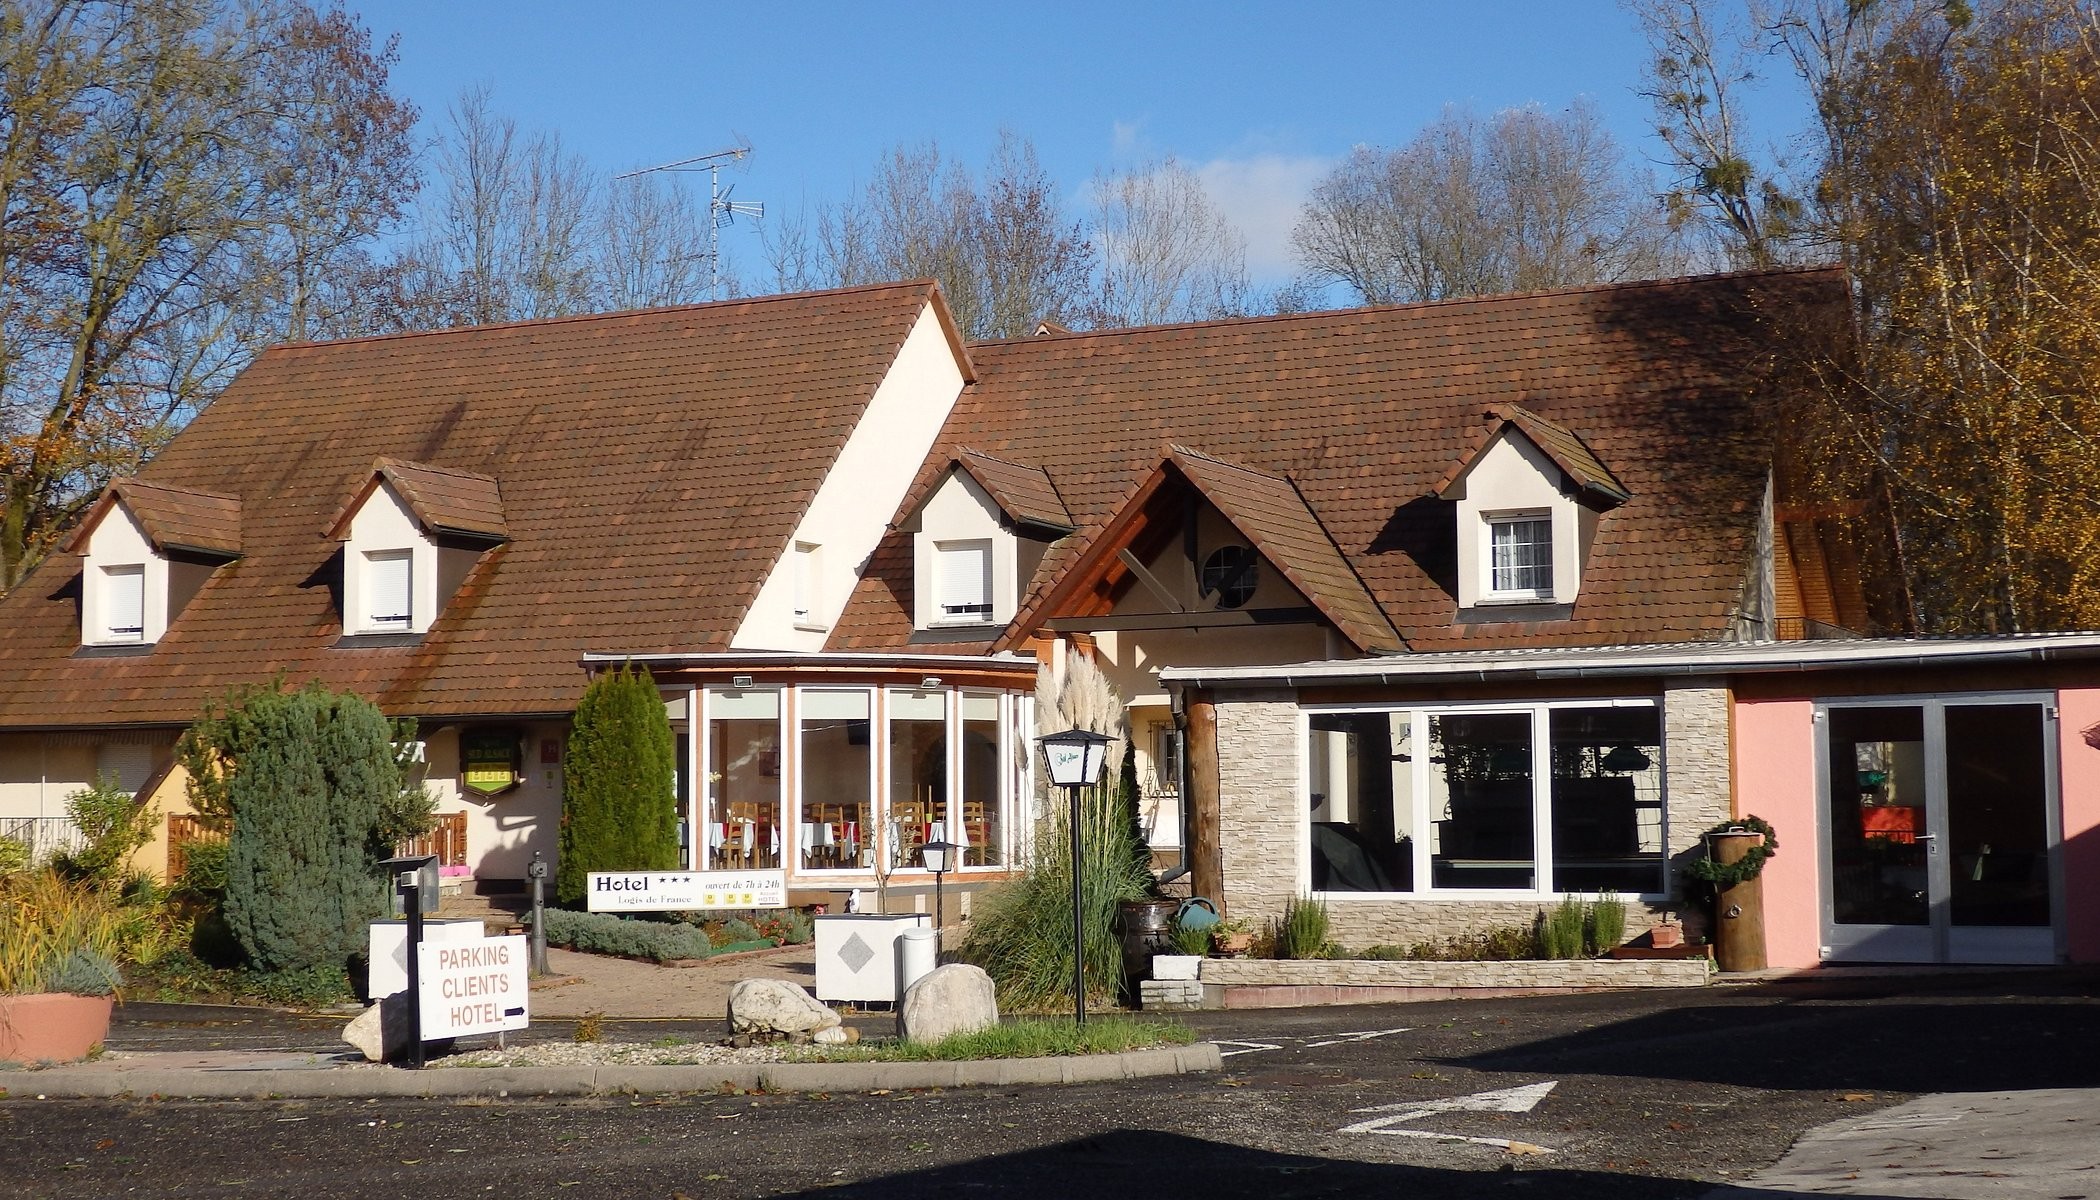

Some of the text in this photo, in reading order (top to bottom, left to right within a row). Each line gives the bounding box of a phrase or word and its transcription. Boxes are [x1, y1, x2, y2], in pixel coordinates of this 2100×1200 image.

[596, 876, 648, 891] Hotel
[705, 879, 780, 889] ouvert de 7h à 24h
[618, 894, 692, 904] Logis de France
[440, 945, 509, 970] PARKING
[442, 973, 509, 999] CLIENTS
[451, 1003, 503, 1028] HOTEL
